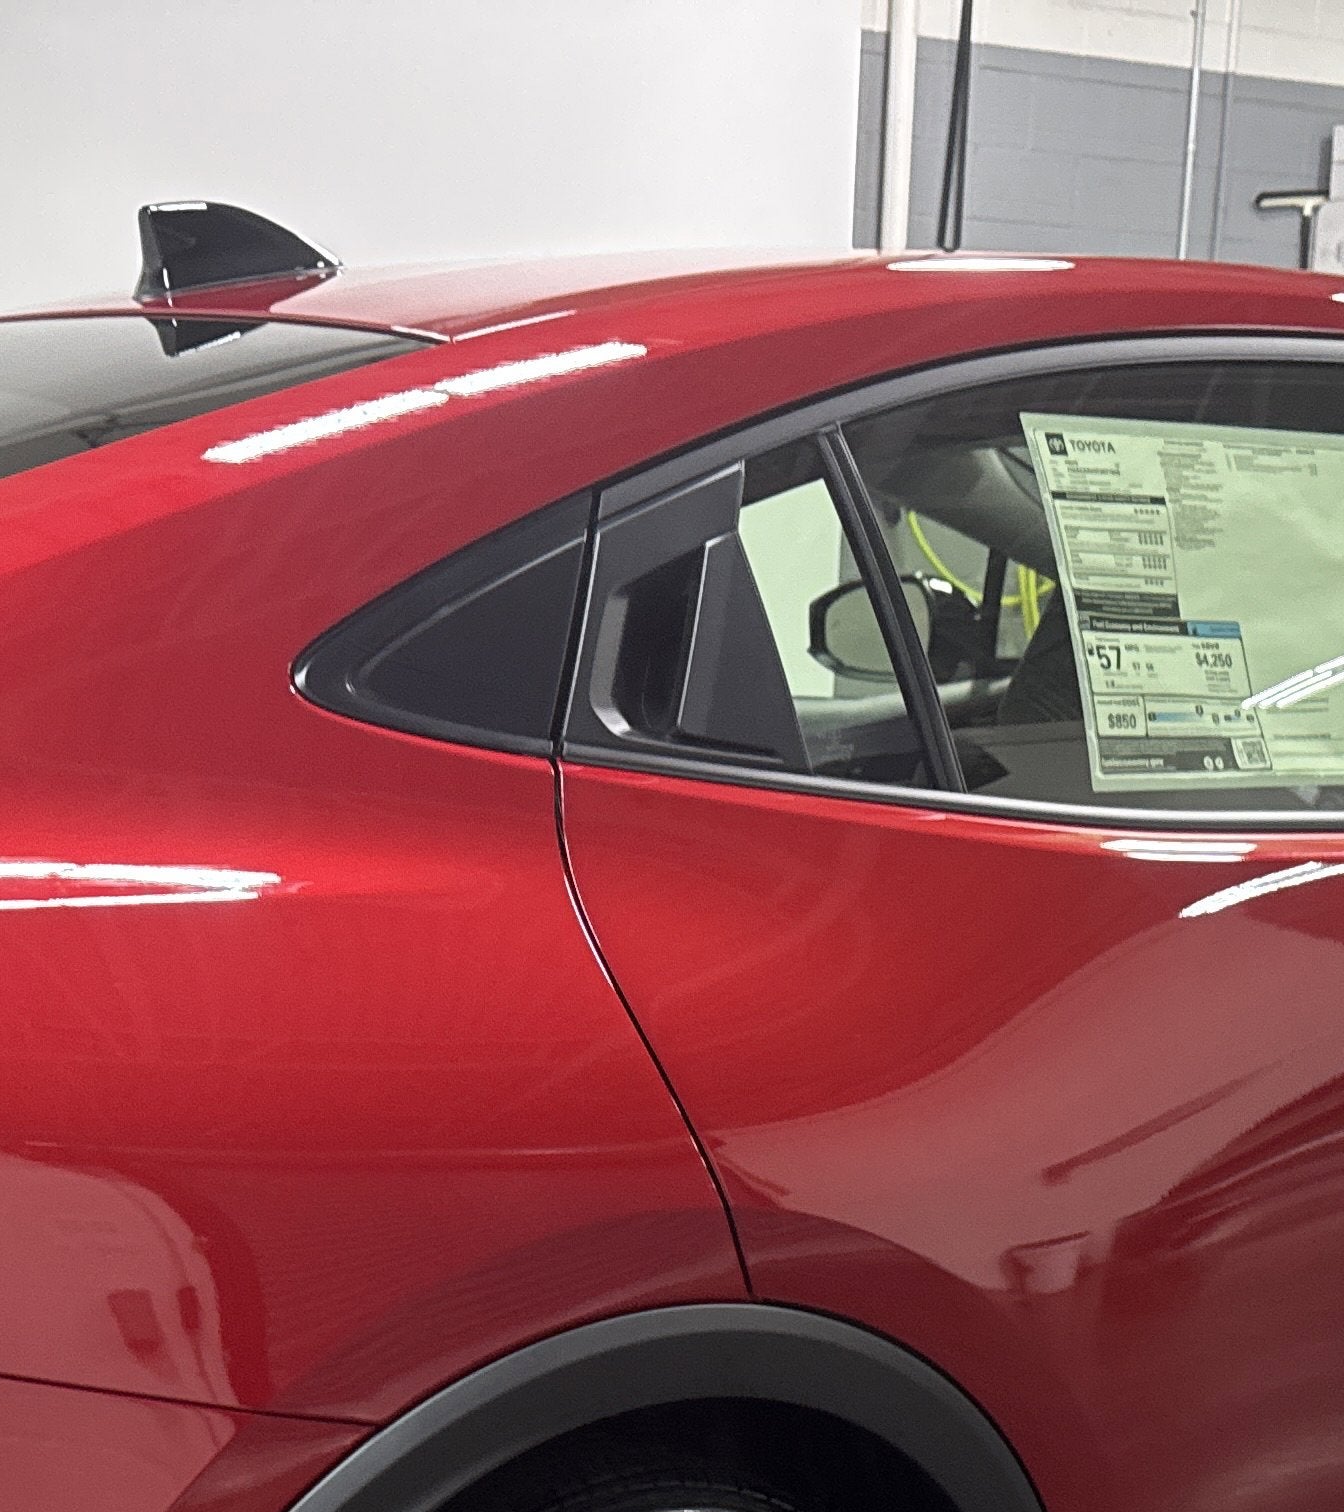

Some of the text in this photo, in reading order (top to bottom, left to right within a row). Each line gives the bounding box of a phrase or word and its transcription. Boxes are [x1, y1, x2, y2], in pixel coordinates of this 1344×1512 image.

[1069, 439, 1116, 455] TOYOTA
[1095, 644, 1122, 671] 57
[1195, 651, 1233, 669] $4,250
[1107, 712, 1137, 730] $850
